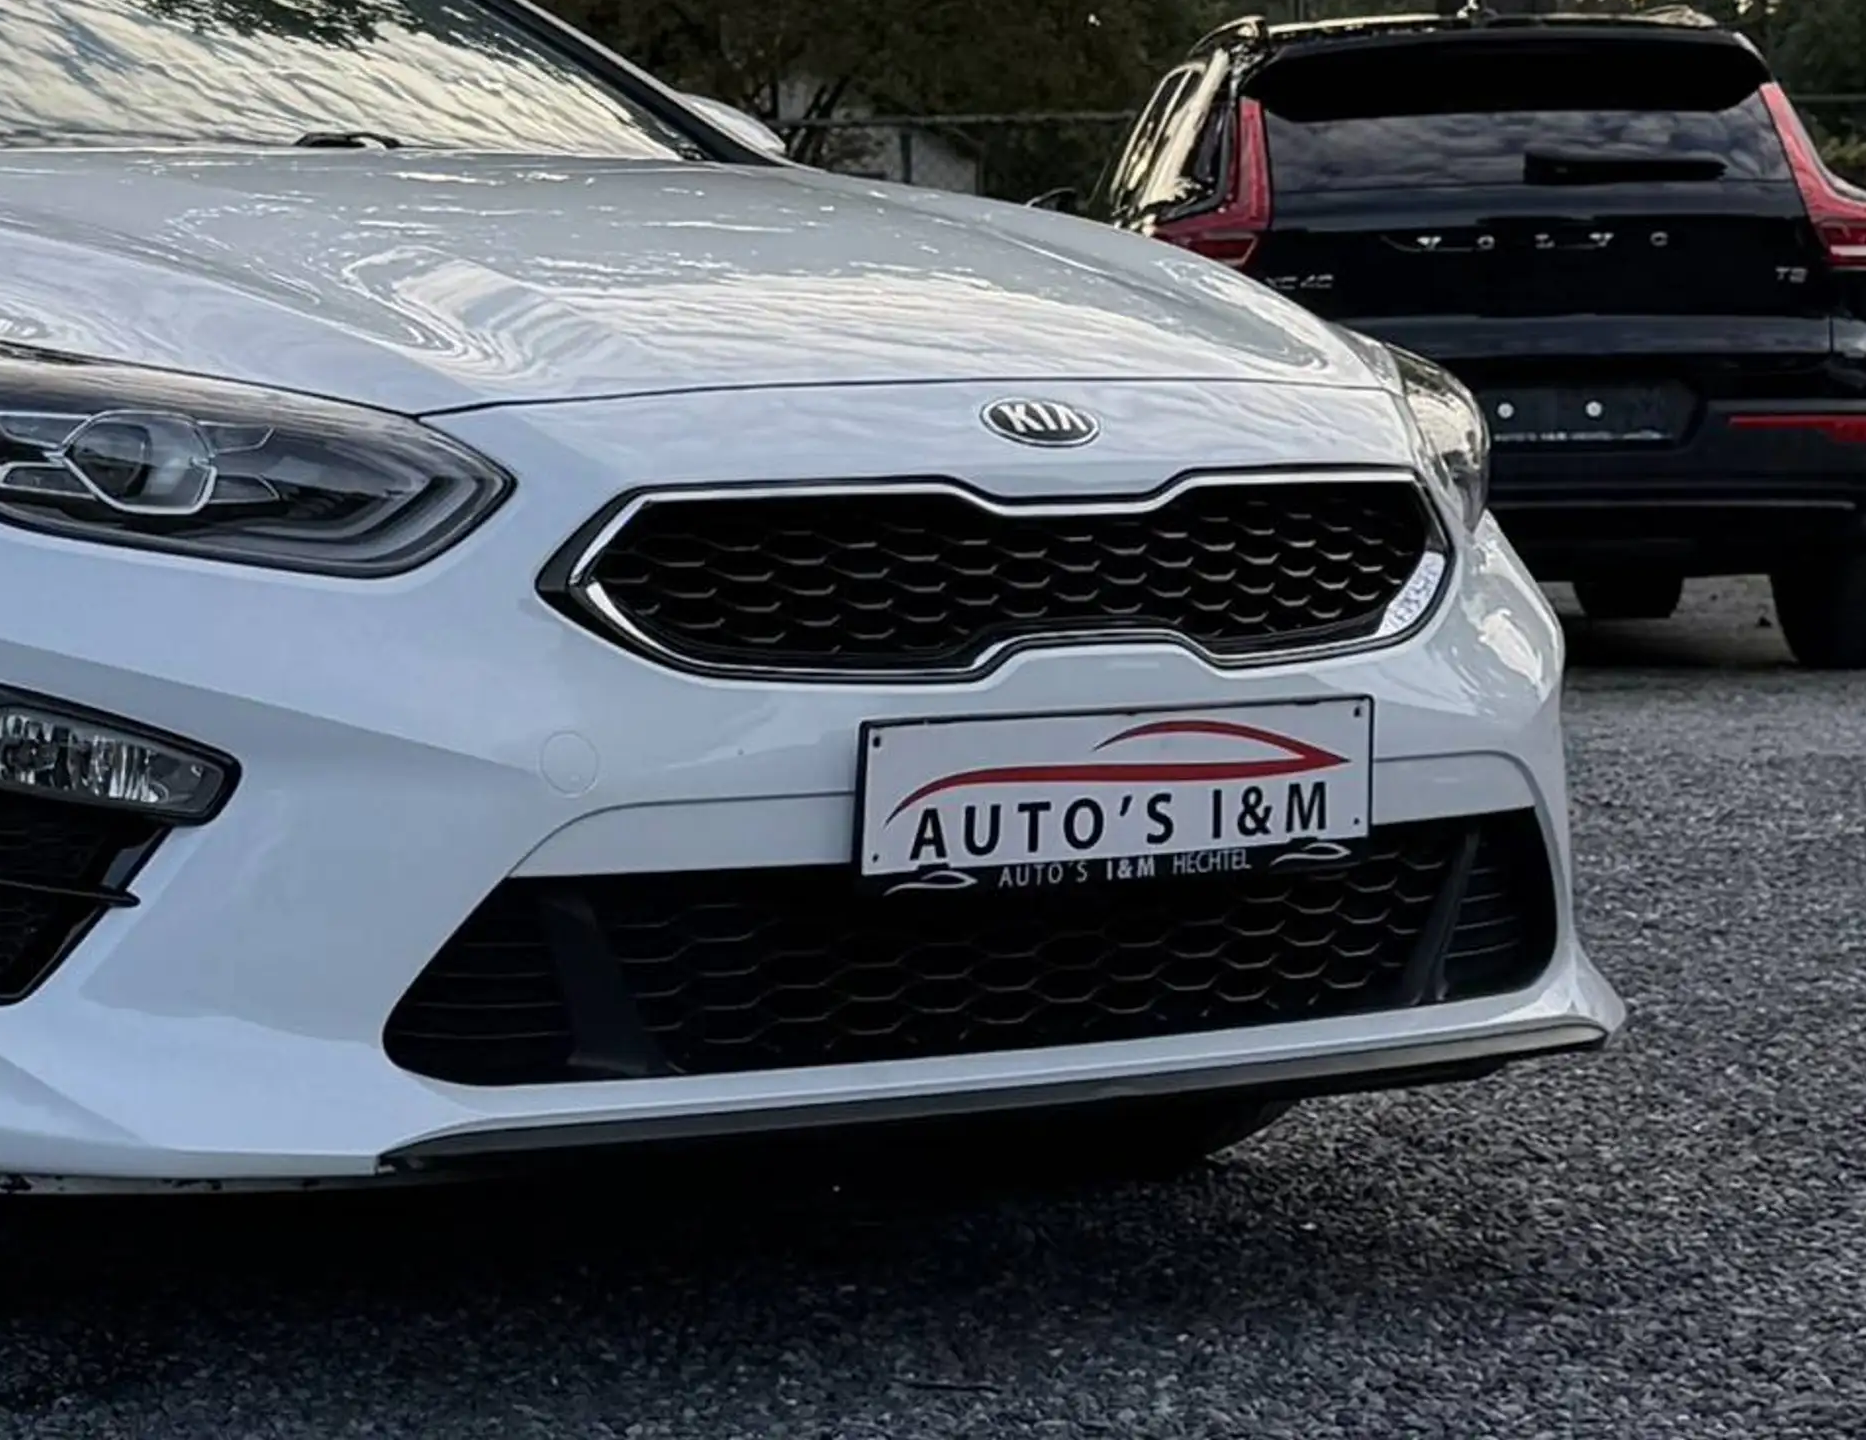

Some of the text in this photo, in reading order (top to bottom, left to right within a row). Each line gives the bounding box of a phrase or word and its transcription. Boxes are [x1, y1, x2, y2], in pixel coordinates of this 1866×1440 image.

[997, 400, 1090, 433] KIA
[909, 781, 1327, 861] AUTO'S I&M
[1106, 860, 1156, 880] I&M
[1172, 849, 1251, 876] HECHTEL
